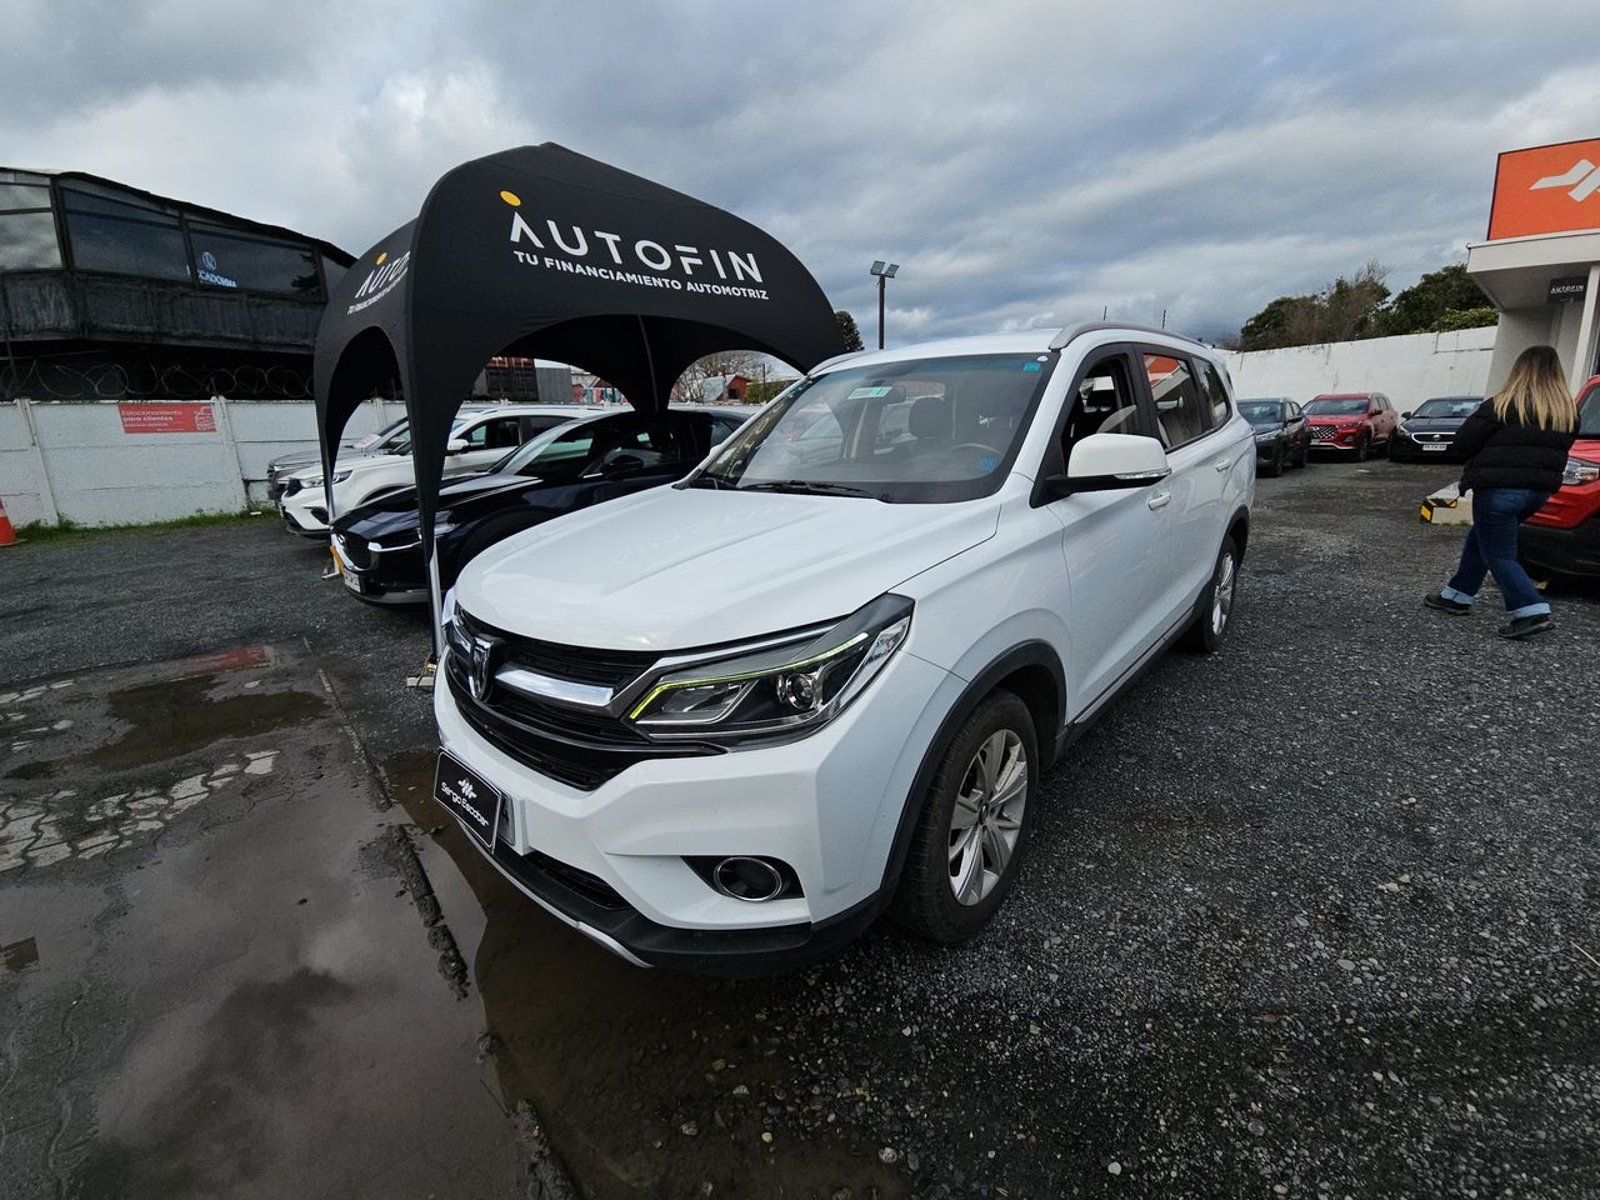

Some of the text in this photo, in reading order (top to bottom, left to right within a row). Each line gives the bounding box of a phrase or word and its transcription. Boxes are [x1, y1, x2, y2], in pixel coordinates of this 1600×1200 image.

[509, 211, 763, 283] AUTOFIN
[513, 251, 769, 300] TU FINANCIAMIENTO AUTOMOTRIZ
